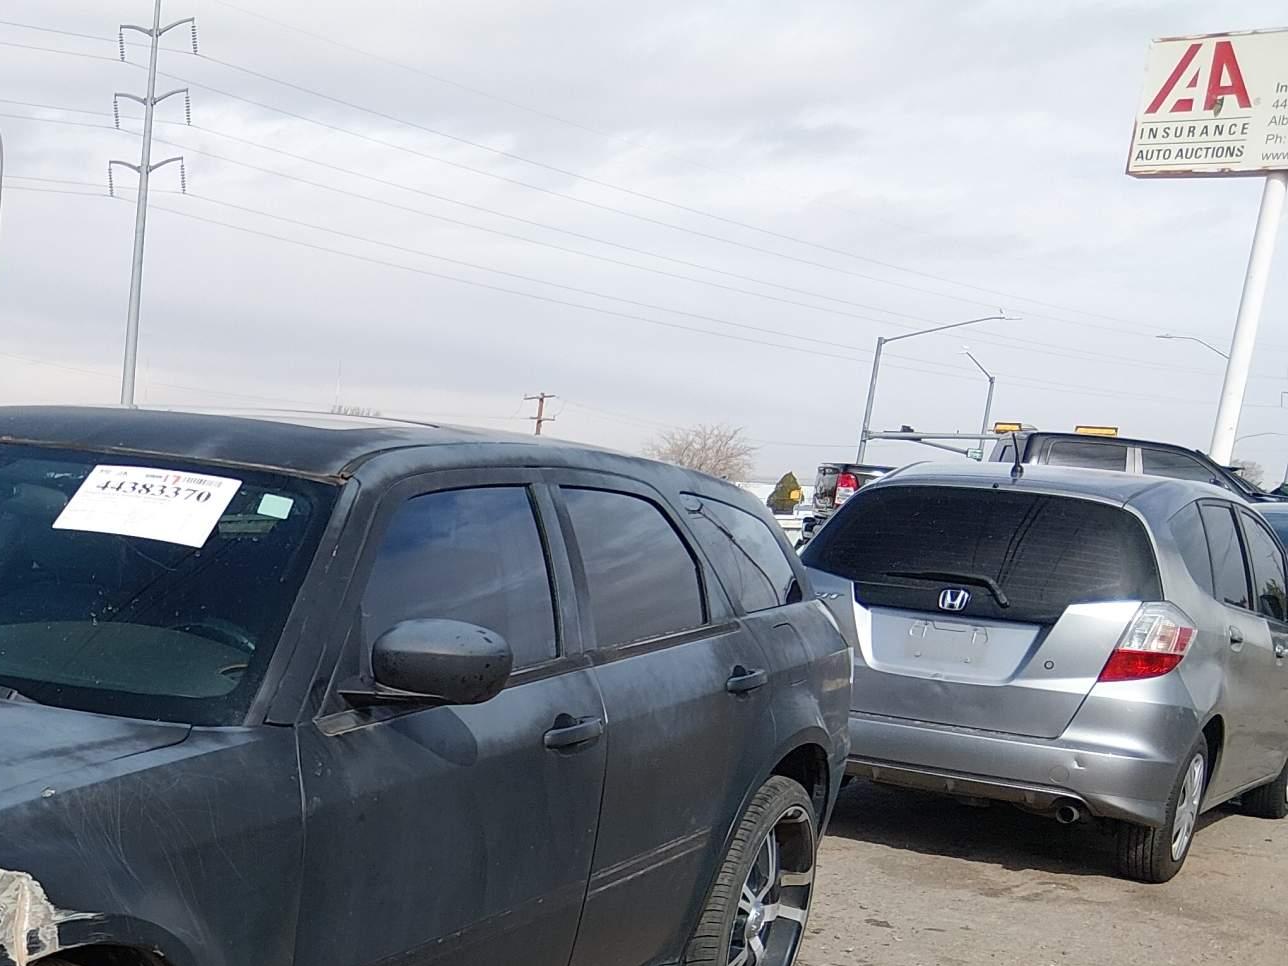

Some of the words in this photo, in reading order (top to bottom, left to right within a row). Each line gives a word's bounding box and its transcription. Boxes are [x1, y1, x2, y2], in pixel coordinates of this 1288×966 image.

[1139, 122, 1250, 140] INSURANCE
[1135, 148, 1172, 162] AUTO
[1174, 145, 1245, 161] AUCTIONS
[95, 479, 213, 504] 44383370
